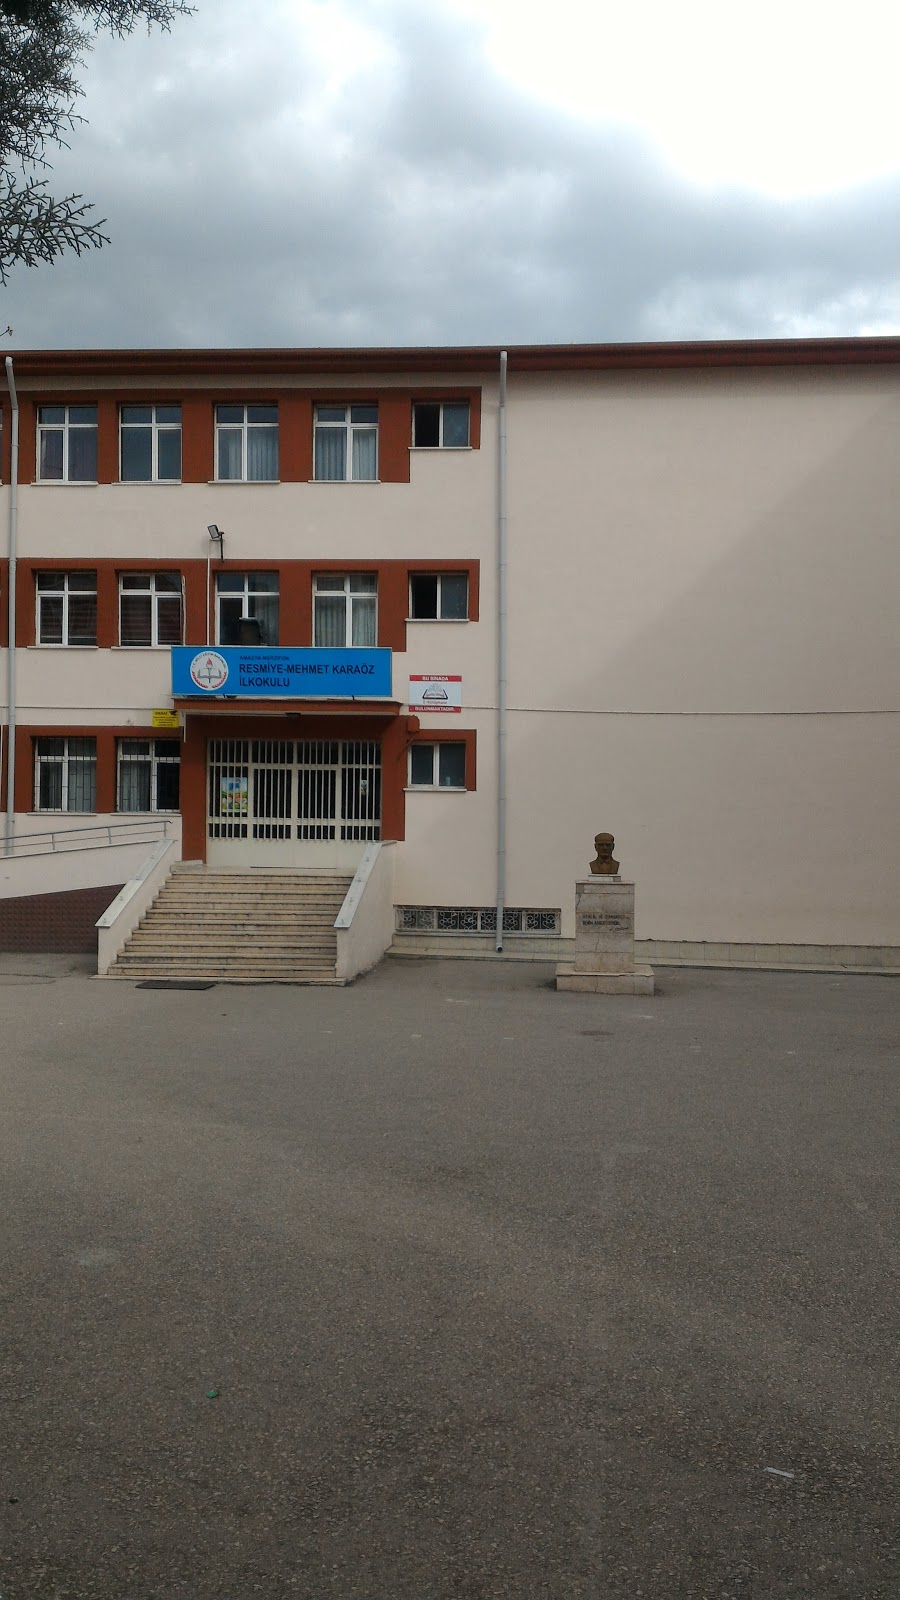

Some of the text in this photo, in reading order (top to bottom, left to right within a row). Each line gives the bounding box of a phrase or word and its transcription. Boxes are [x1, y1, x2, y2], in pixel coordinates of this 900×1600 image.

[239, 663, 375, 674] RESMİYE-MEHMET KARAÖZ
[239, 675, 290, 687] İLKOKULU
